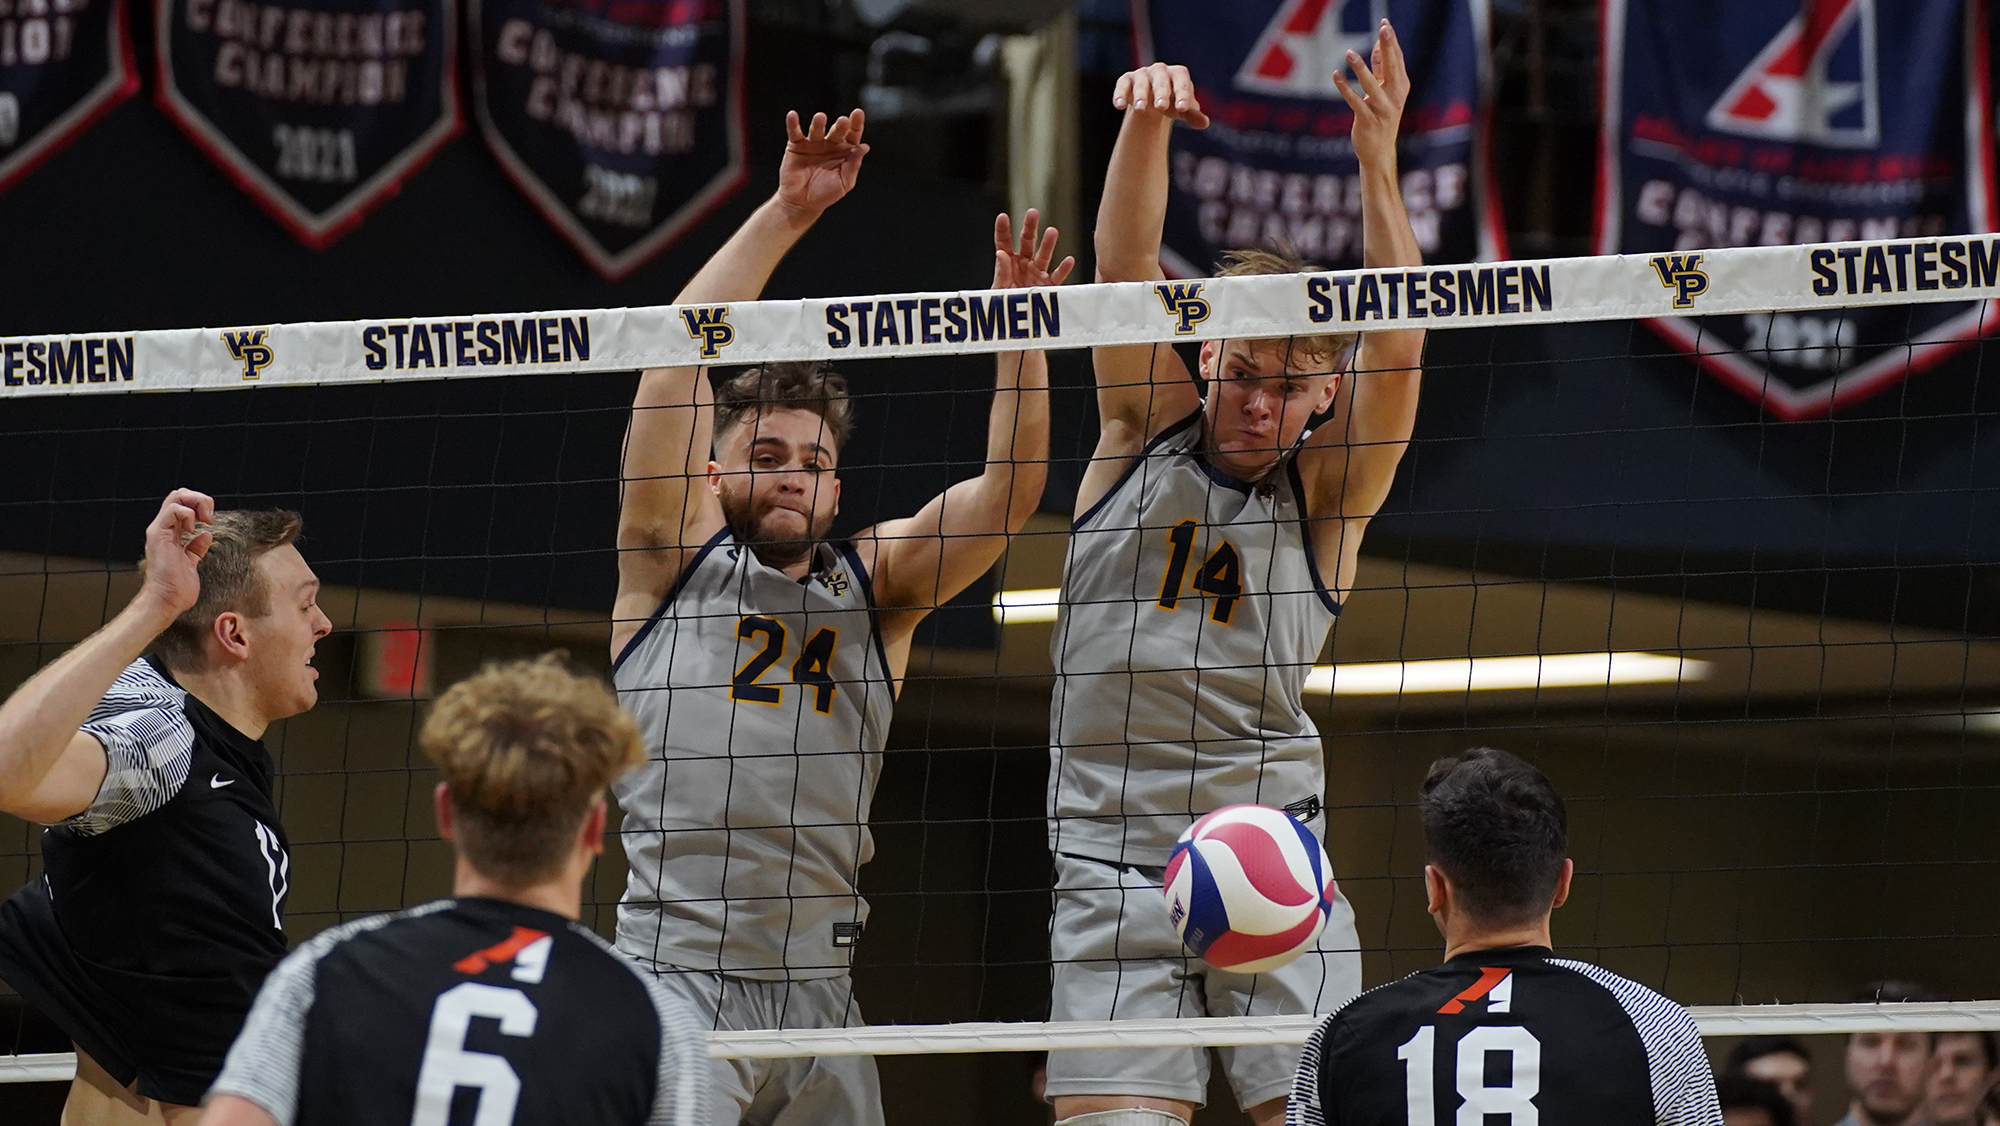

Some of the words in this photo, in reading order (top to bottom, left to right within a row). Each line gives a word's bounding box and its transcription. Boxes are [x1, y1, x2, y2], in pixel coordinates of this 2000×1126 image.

[1172, 150, 1466, 219] CONFERECE
[1197, 200, 1441, 258] CHAMPIN
[0, 336, 135, 387] ESMEN
[363, 316, 590, 370] STATESMEN
[825, 292, 1060, 349] STATESMEN
[1307, 265, 1553, 323] STATESMEN
[1811, 238, 2000, 296] STATESM
[1156, 518, 1243, 626] 14
[729, 615, 839, 716] 24
[410, 981, 539, 1126] 6
[1397, 1025, 1541, 1126] 18
